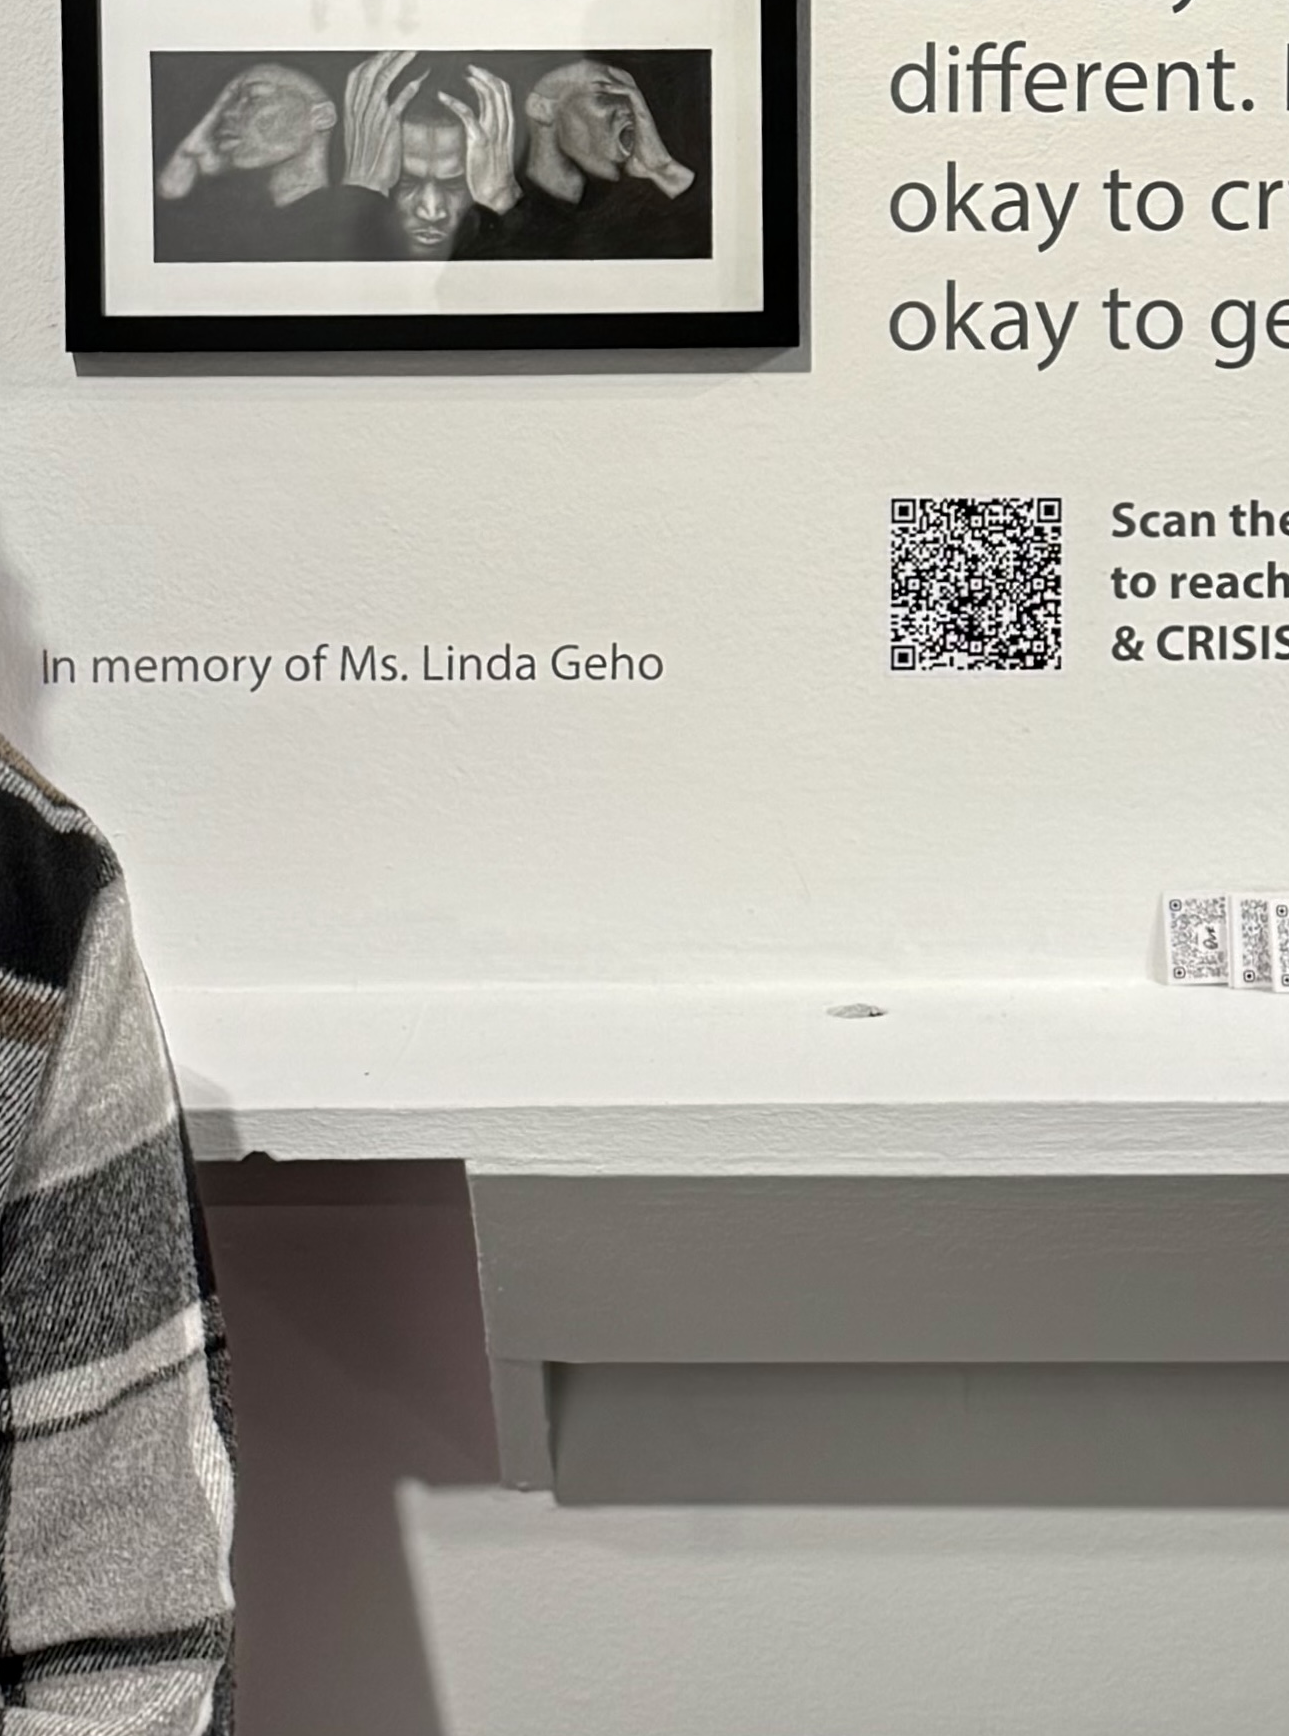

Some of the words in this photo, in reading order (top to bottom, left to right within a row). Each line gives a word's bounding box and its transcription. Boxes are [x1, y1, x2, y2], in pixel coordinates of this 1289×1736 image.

[888, 38, 1256, 116] different.
[888, 159, 1082, 255] okay
[1101, 167, 1186, 233] to
[887, 277, 1081, 373] okay
[1100, 286, 1185, 352] to
[1110, 500, 1218, 540] Scan
[1108, 565, 1158, 602] to
[39, 646, 77, 687] In
[91, 654, 274, 695] memory
[283, 641, 334, 685] of
[338, 643, 410, 684] Ms.
[422, 641, 538, 683] Linda
[549, 640, 665, 682] Geho
[1109, 623, 1146, 663] &
